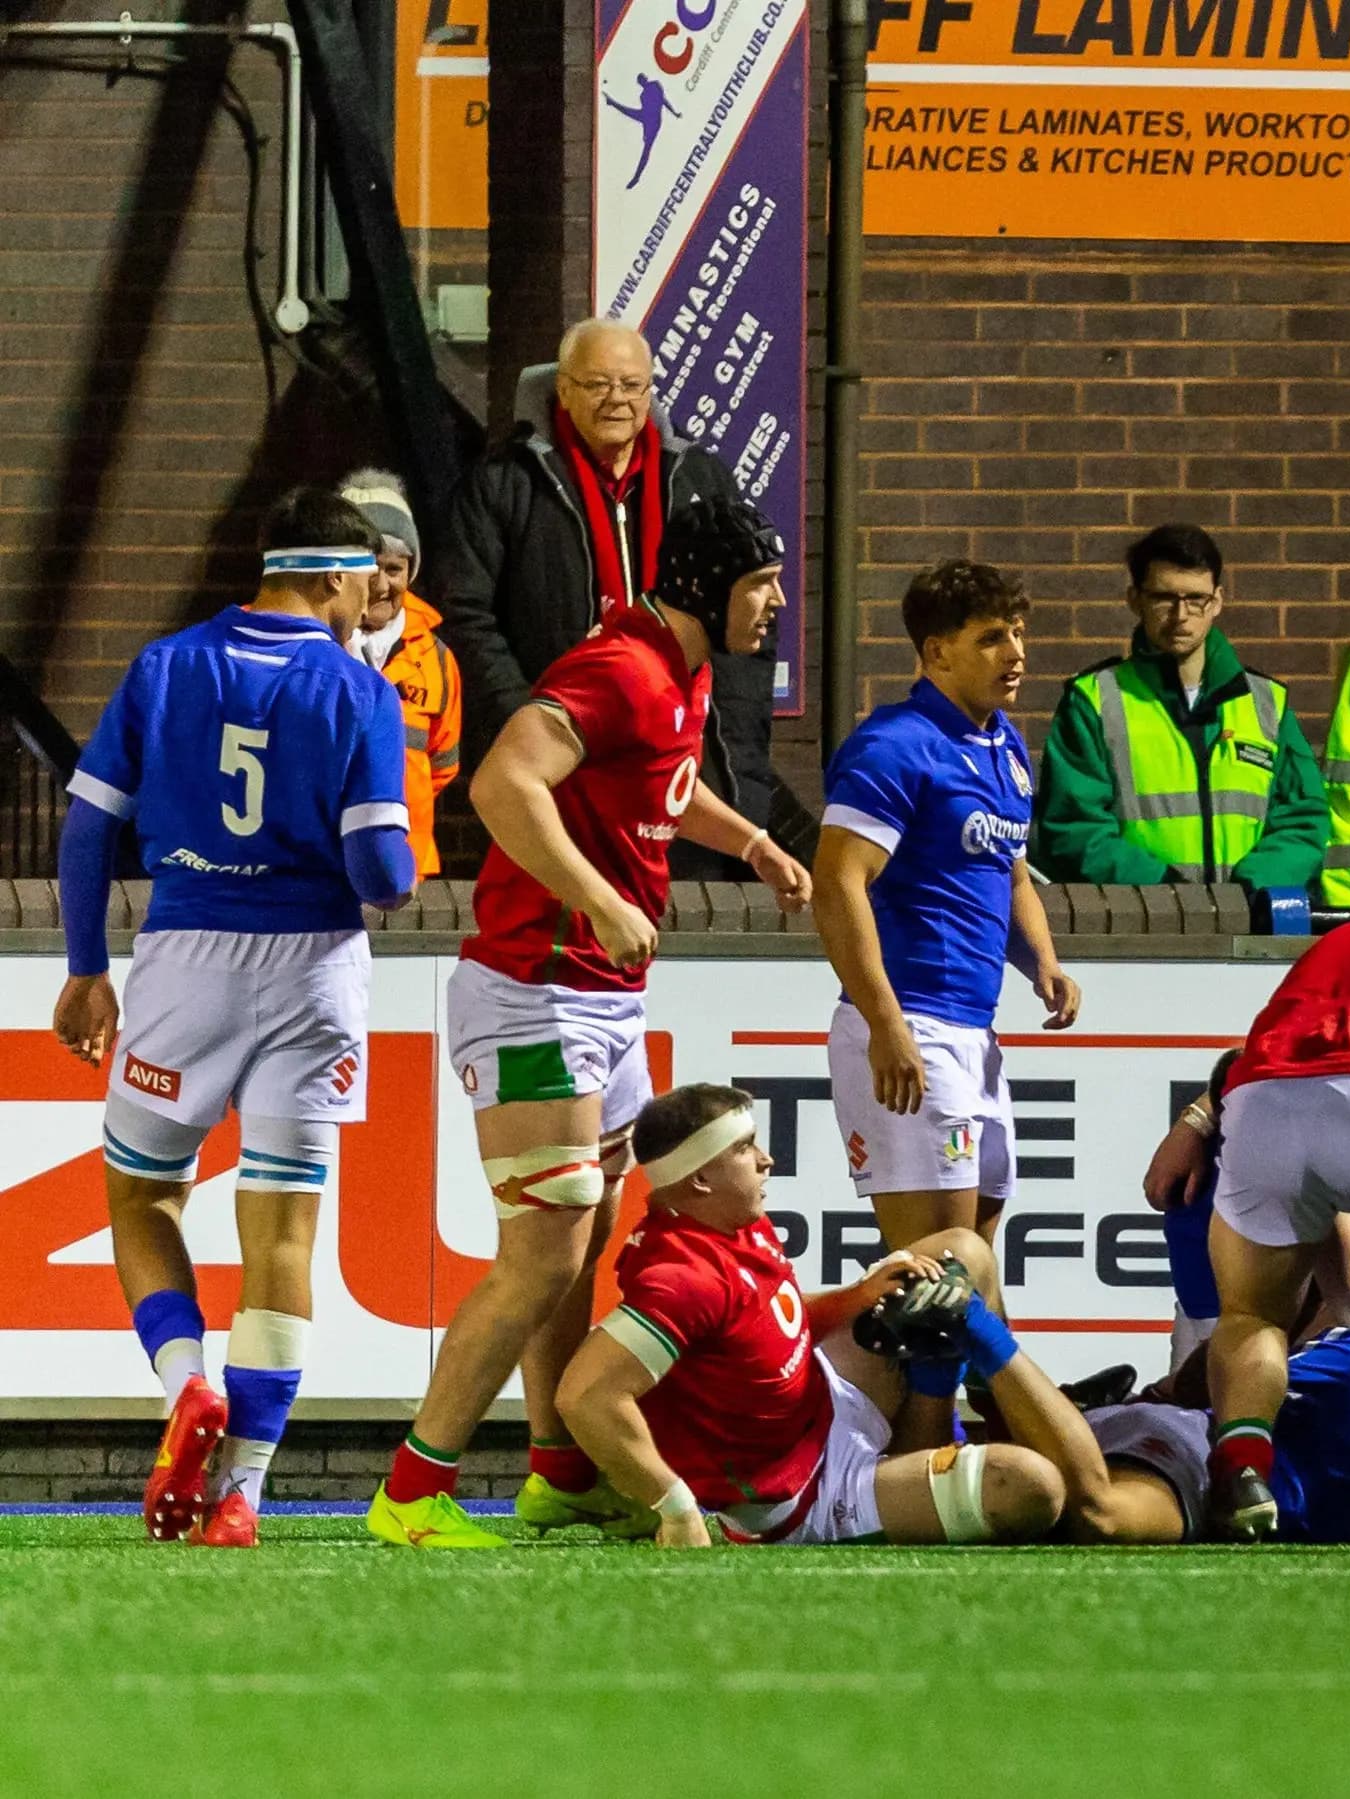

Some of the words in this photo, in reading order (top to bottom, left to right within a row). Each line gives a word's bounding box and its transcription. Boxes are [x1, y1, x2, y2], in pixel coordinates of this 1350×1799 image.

[685, 43, 715, 93] Cardiff
[711, 0, 743, 43] Centra
[604, 0, 788, 321] WWW.CARDIFFCENTRALYOUTHCLUB.CO.
[865, 106, 990, 134] RATIVE
[1000, 108, 1192, 141] LAMINATES,
[1018, 148, 1040, 173] &
[1051, 148, 1195, 175] KITCHEN
[651, 183, 760, 395] YMNASTICS
[697, 323, 713, 341] &
[706, 197, 777, 322] Recreational
[710, 412, 732, 440] No
[729, 331, 775, 410] contract
[714, 311, 760, 385] GYM
[750, 430, 791, 498] Options
[218, 723, 269, 837] 5
[129, 1064, 173, 1094] AVIS
[731, 1077, 1075, 1179] TE
